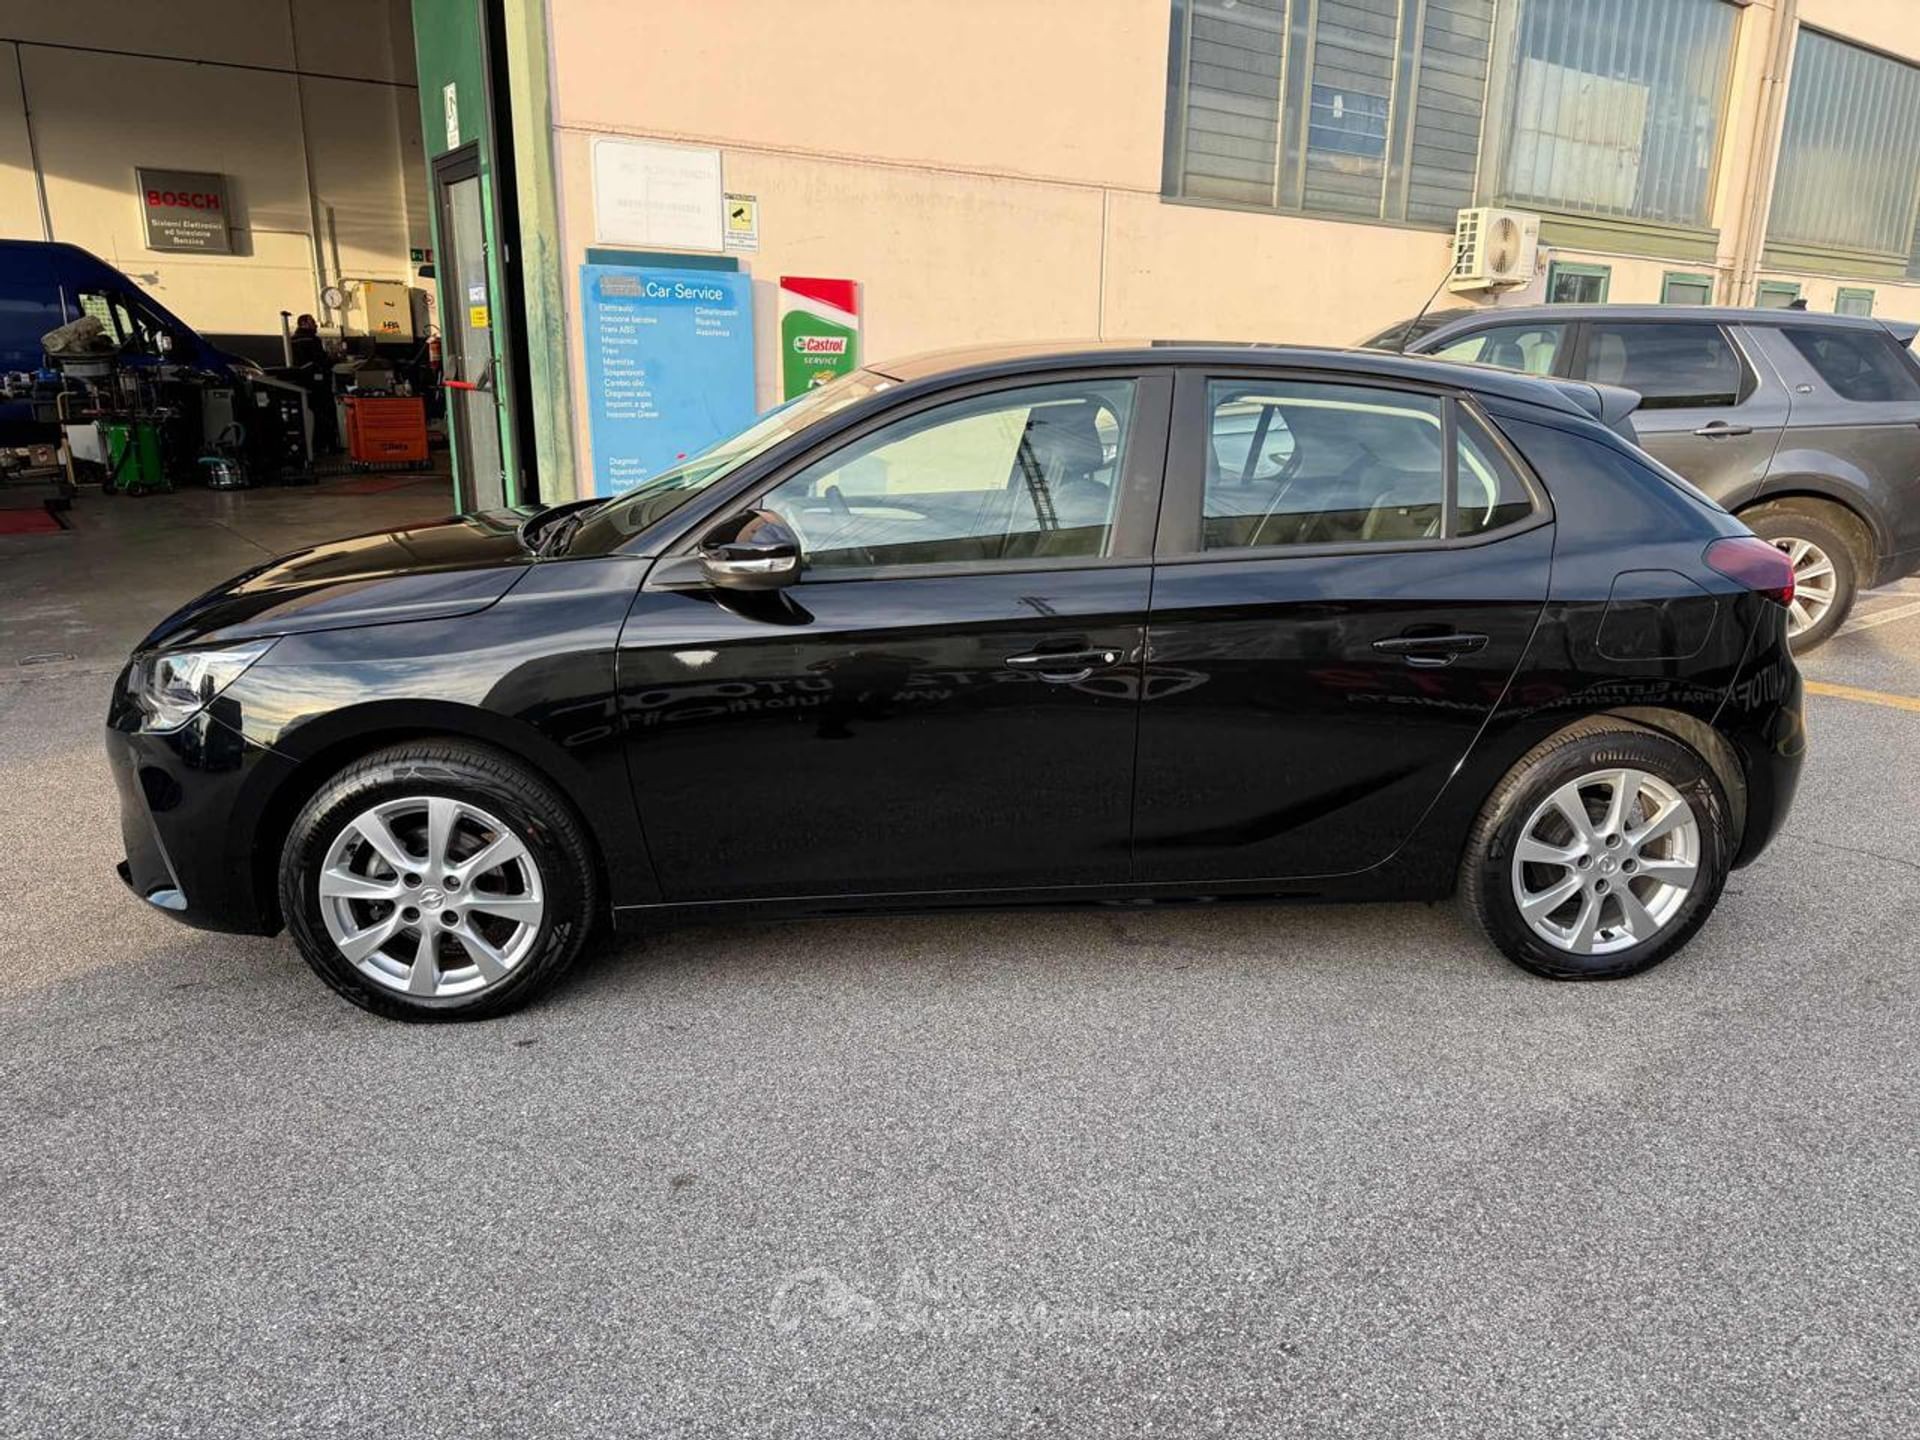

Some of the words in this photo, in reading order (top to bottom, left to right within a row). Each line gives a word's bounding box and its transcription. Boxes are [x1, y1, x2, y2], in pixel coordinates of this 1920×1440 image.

[147, 190, 220, 210] BOSCH
[646, 282, 671, 298] Car
[675, 283, 723, 300] Service
[807, 338, 843, 352] Castrol
[804, 356, 838, 366] SERVICE
